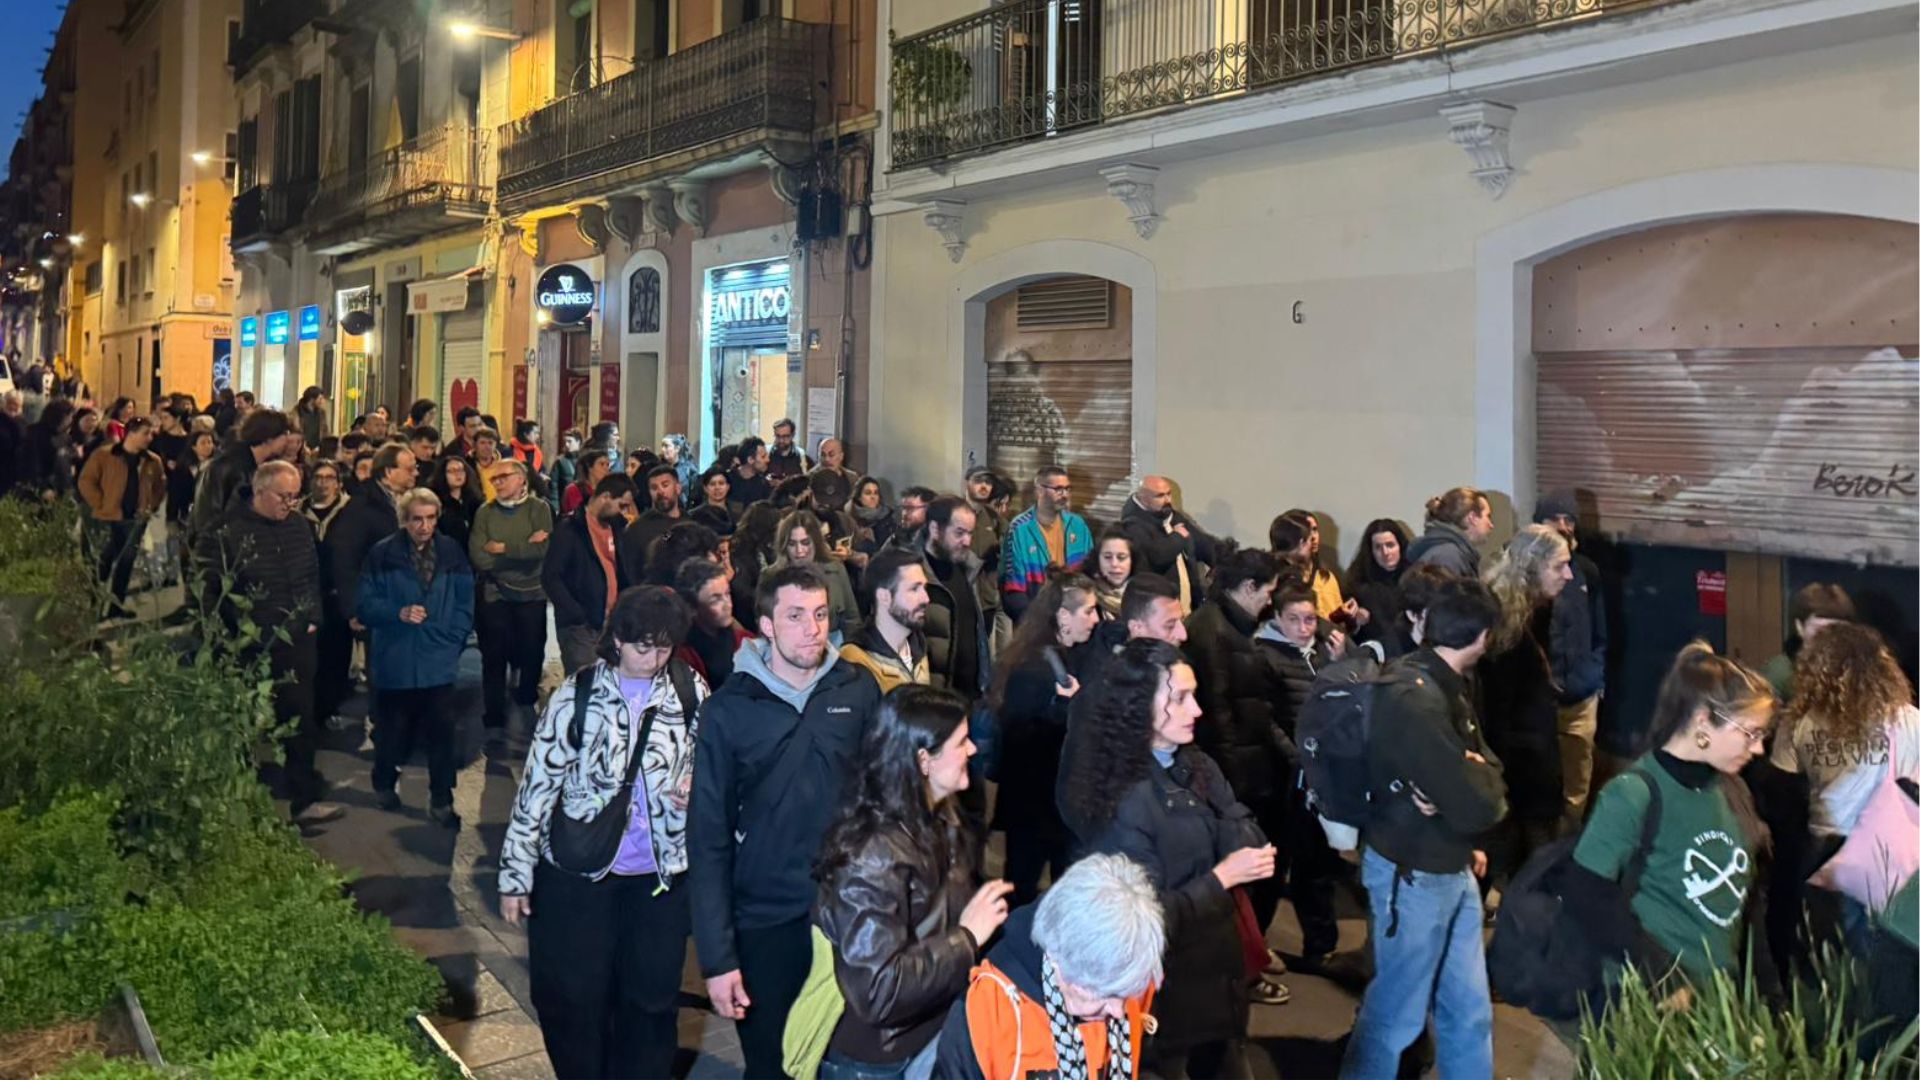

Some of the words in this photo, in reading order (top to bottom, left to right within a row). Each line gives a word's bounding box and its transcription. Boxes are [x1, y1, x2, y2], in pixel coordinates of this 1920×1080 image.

[540, 291, 593, 306] GUINNESS
[717, 286, 790, 322] ANTICO
[1851, 752, 1889, 766] VILA
